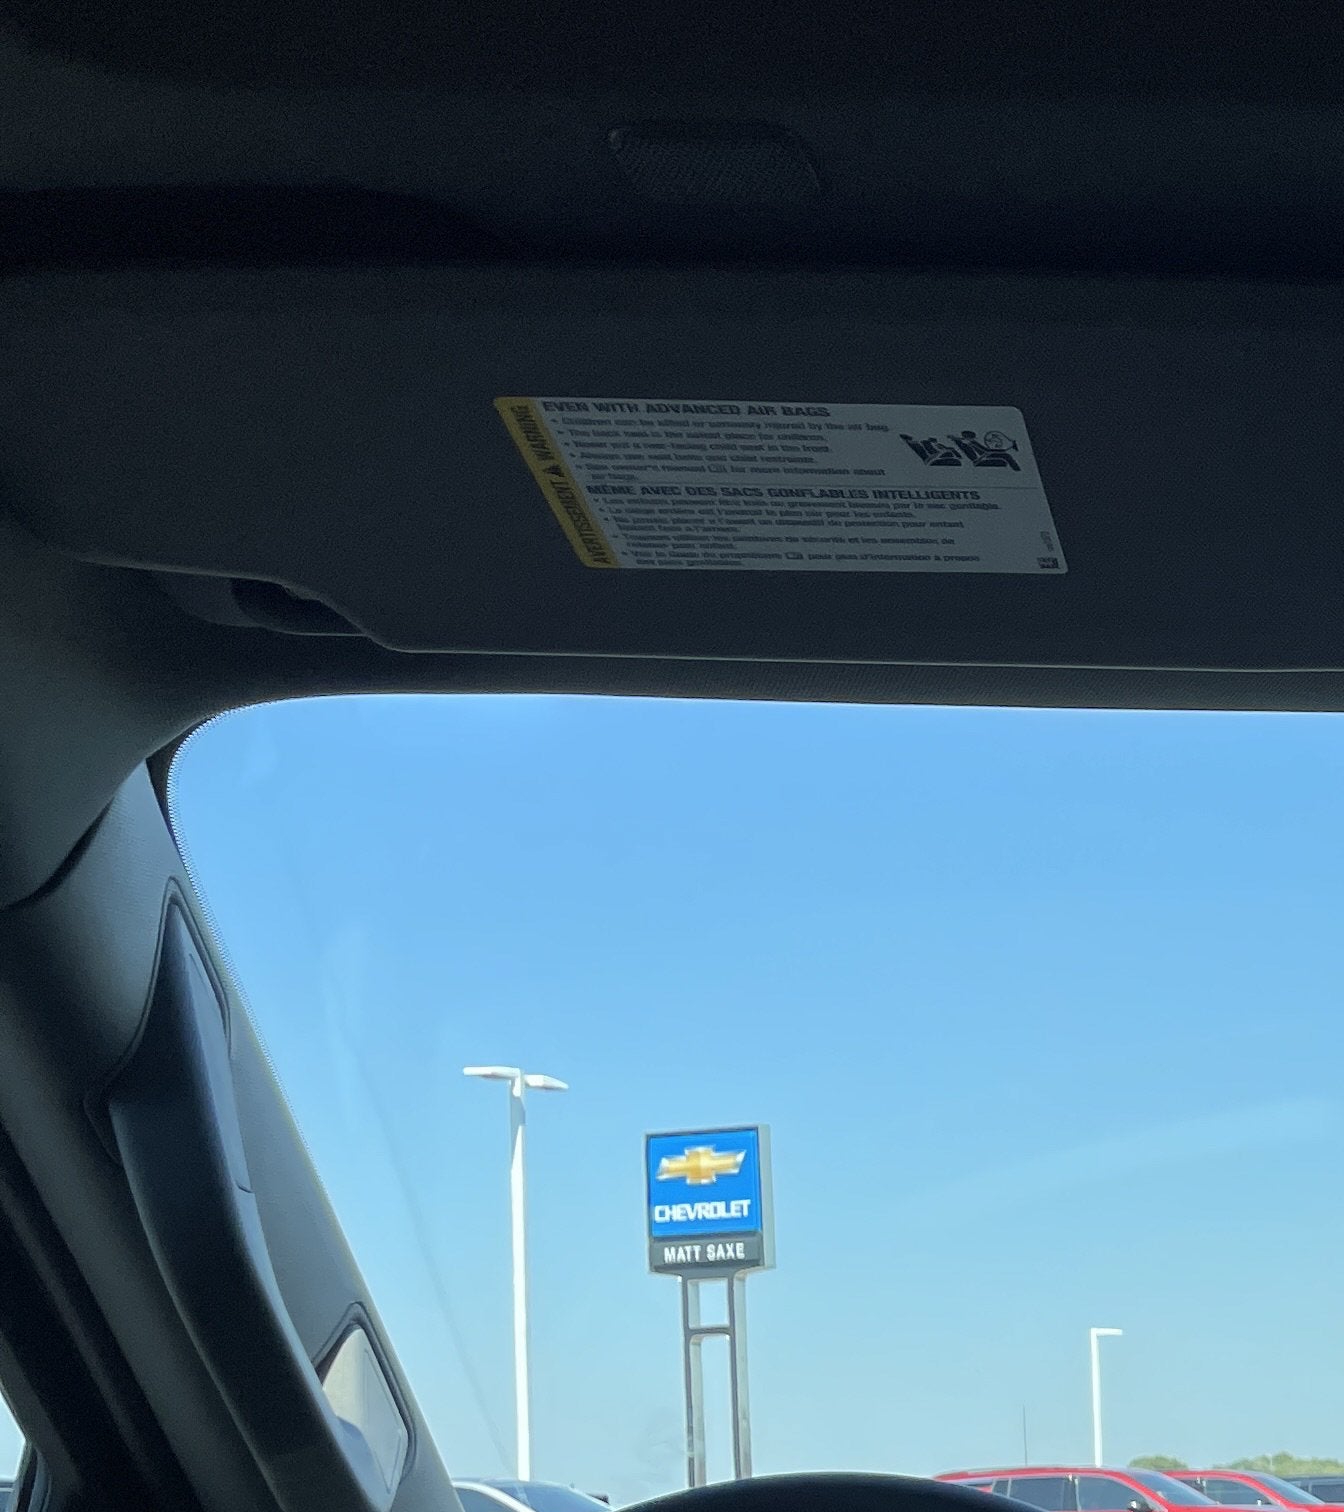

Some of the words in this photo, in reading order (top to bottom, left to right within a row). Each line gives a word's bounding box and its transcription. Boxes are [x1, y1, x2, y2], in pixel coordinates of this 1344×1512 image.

[542, 401, 590, 413] EVEN
[591, 402, 639, 414] WITH
[646, 403, 741, 415] ADVANCED
[747, 405, 777, 416] AIR
[781, 406, 831, 418] BAGS
[641, 484, 682, 497] AVEC
[685, 485, 718, 498] DES
[720, 486, 764, 498] SACS
[873, 489, 980, 501] INTELLIGENTS
[654, 1198, 752, 1224] CHEVROLET
[664, 1245, 702, 1264] MATT
[706, 1242, 745, 1262] SAXE
